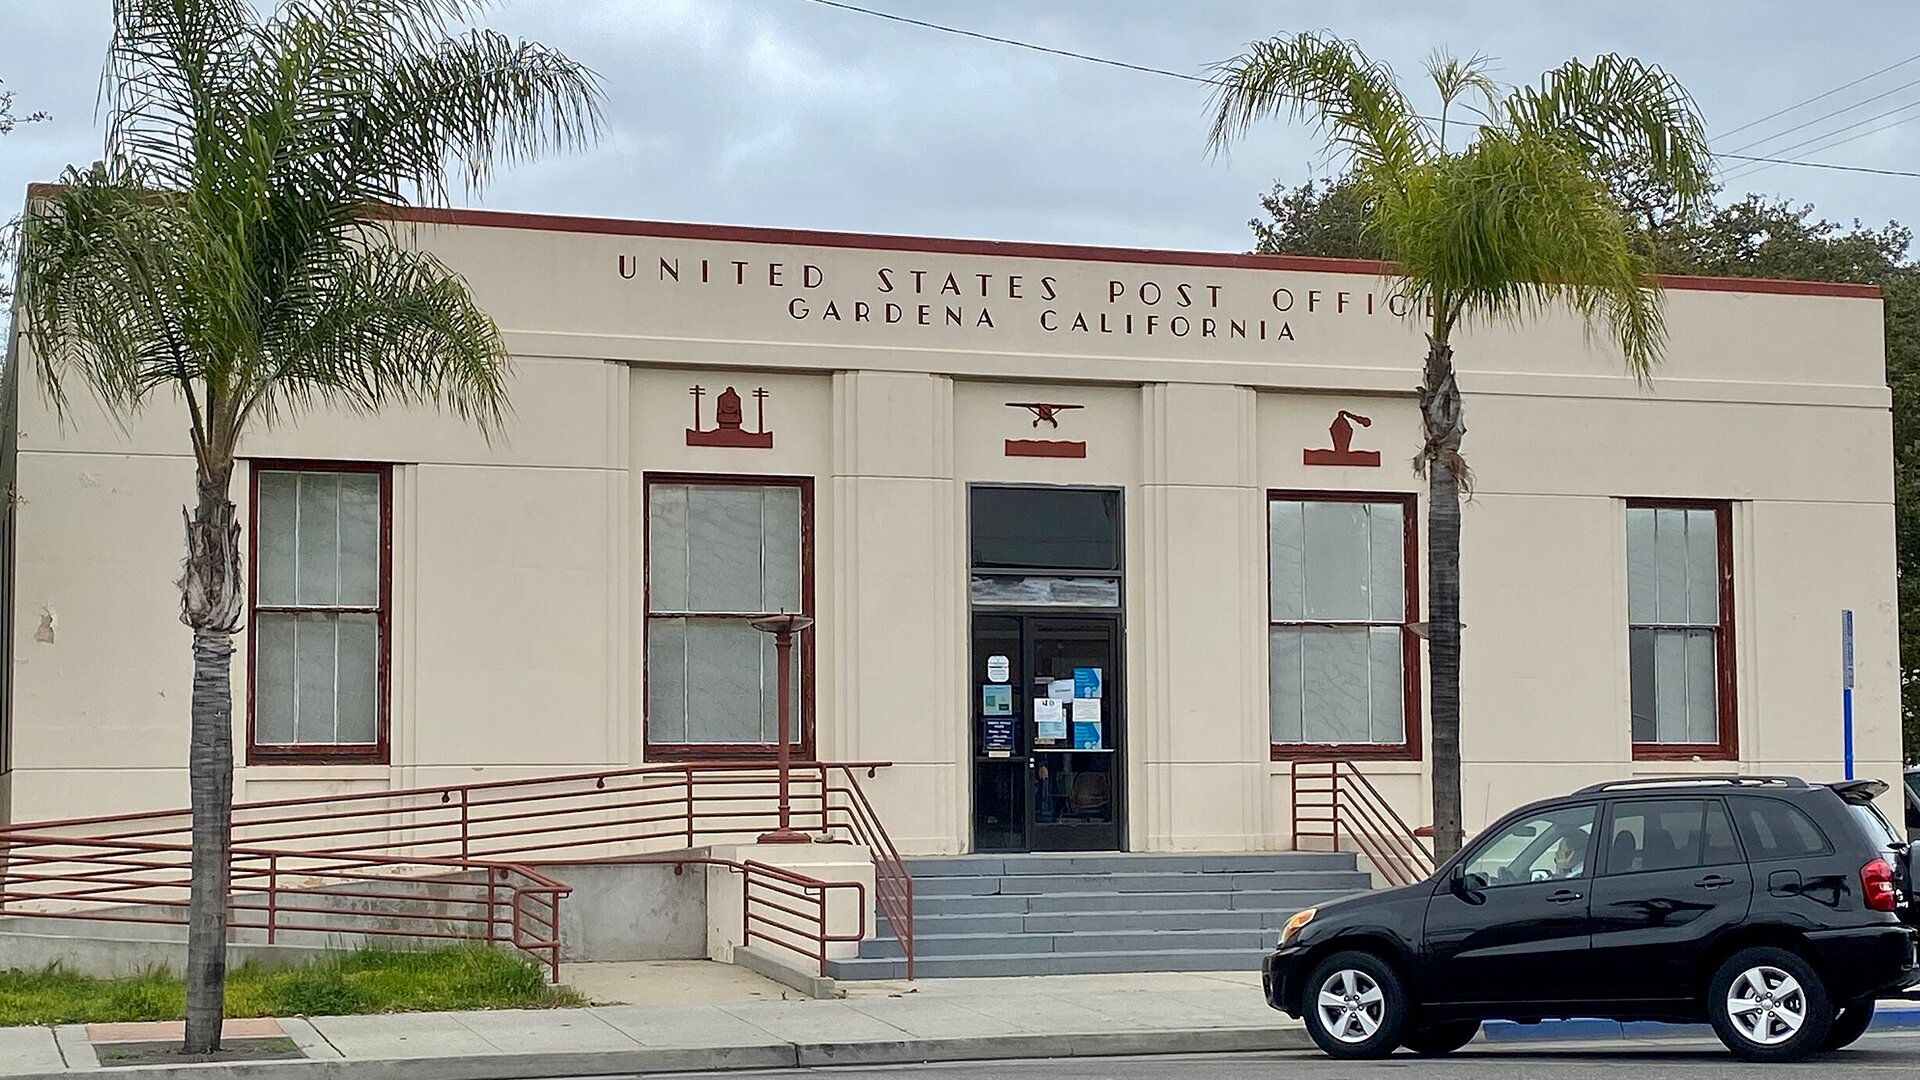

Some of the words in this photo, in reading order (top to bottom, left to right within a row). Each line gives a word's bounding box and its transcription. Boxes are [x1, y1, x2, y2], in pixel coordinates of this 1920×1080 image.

[619, 254, 823, 289] UNITED
[877, 268, 1057, 301] STATES
[1109, 280, 1223, 308] POST
[788, 297, 995, 329] GARDENA
[1040, 309, 1295, 341] CALIFORNIA
